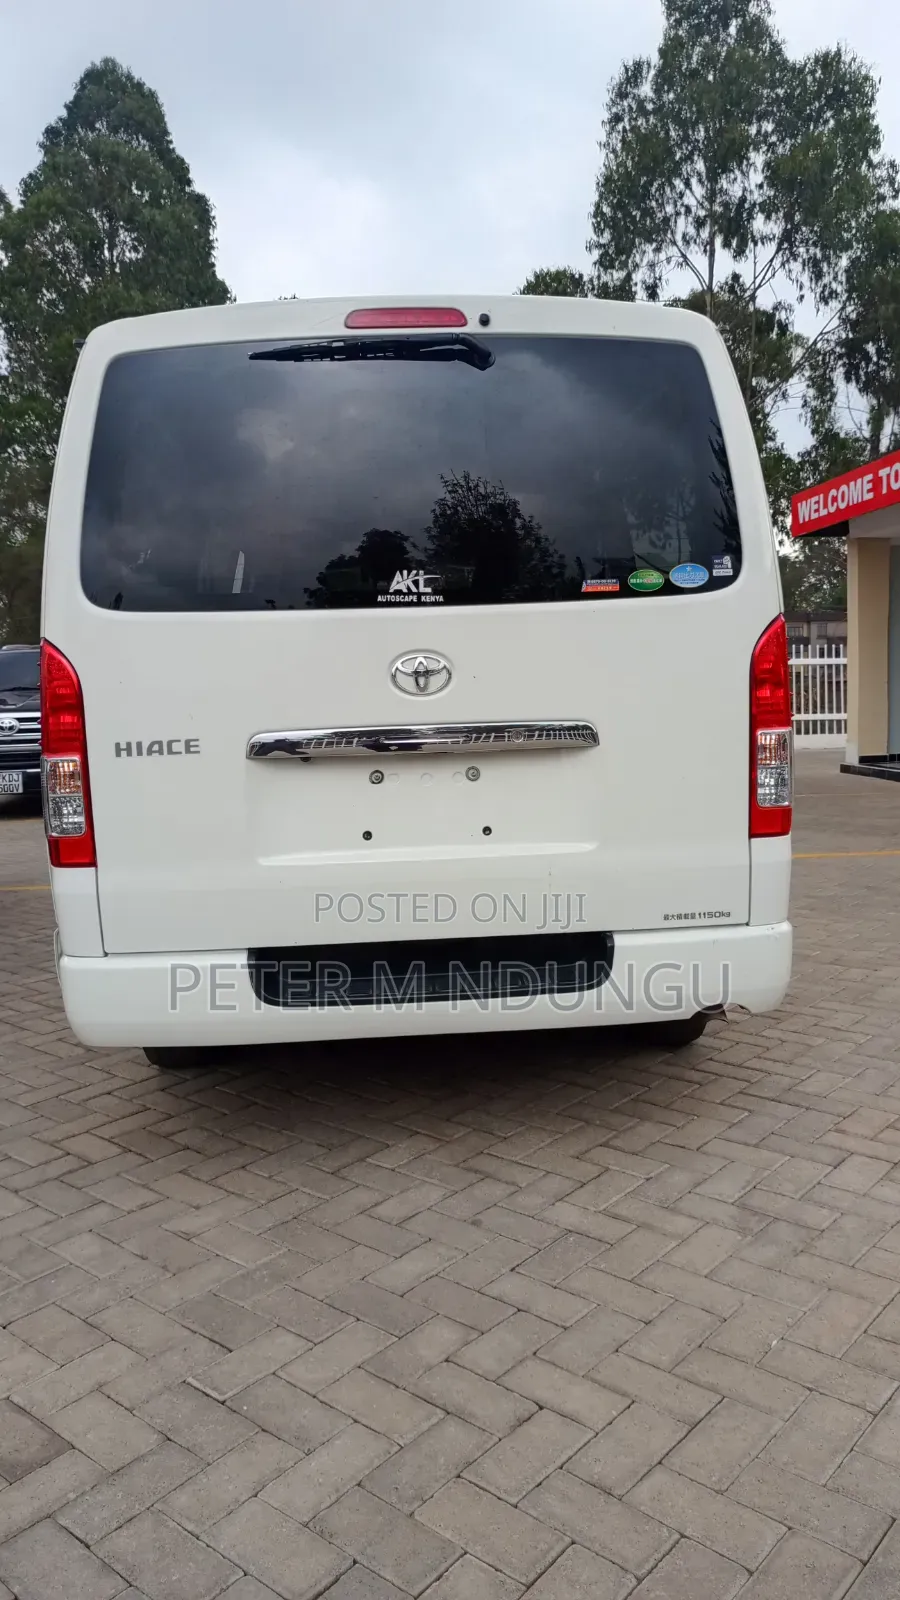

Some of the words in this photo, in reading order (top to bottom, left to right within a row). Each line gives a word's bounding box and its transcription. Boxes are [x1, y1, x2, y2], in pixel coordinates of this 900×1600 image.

[797, 473, 874, 524] WELCOME
[878, 462, 900, 495] TO
[388, 569, 441, 593] AKL
[114, 738, 201, 758] HIACE
[1, 773, 20, 783] KDJ
